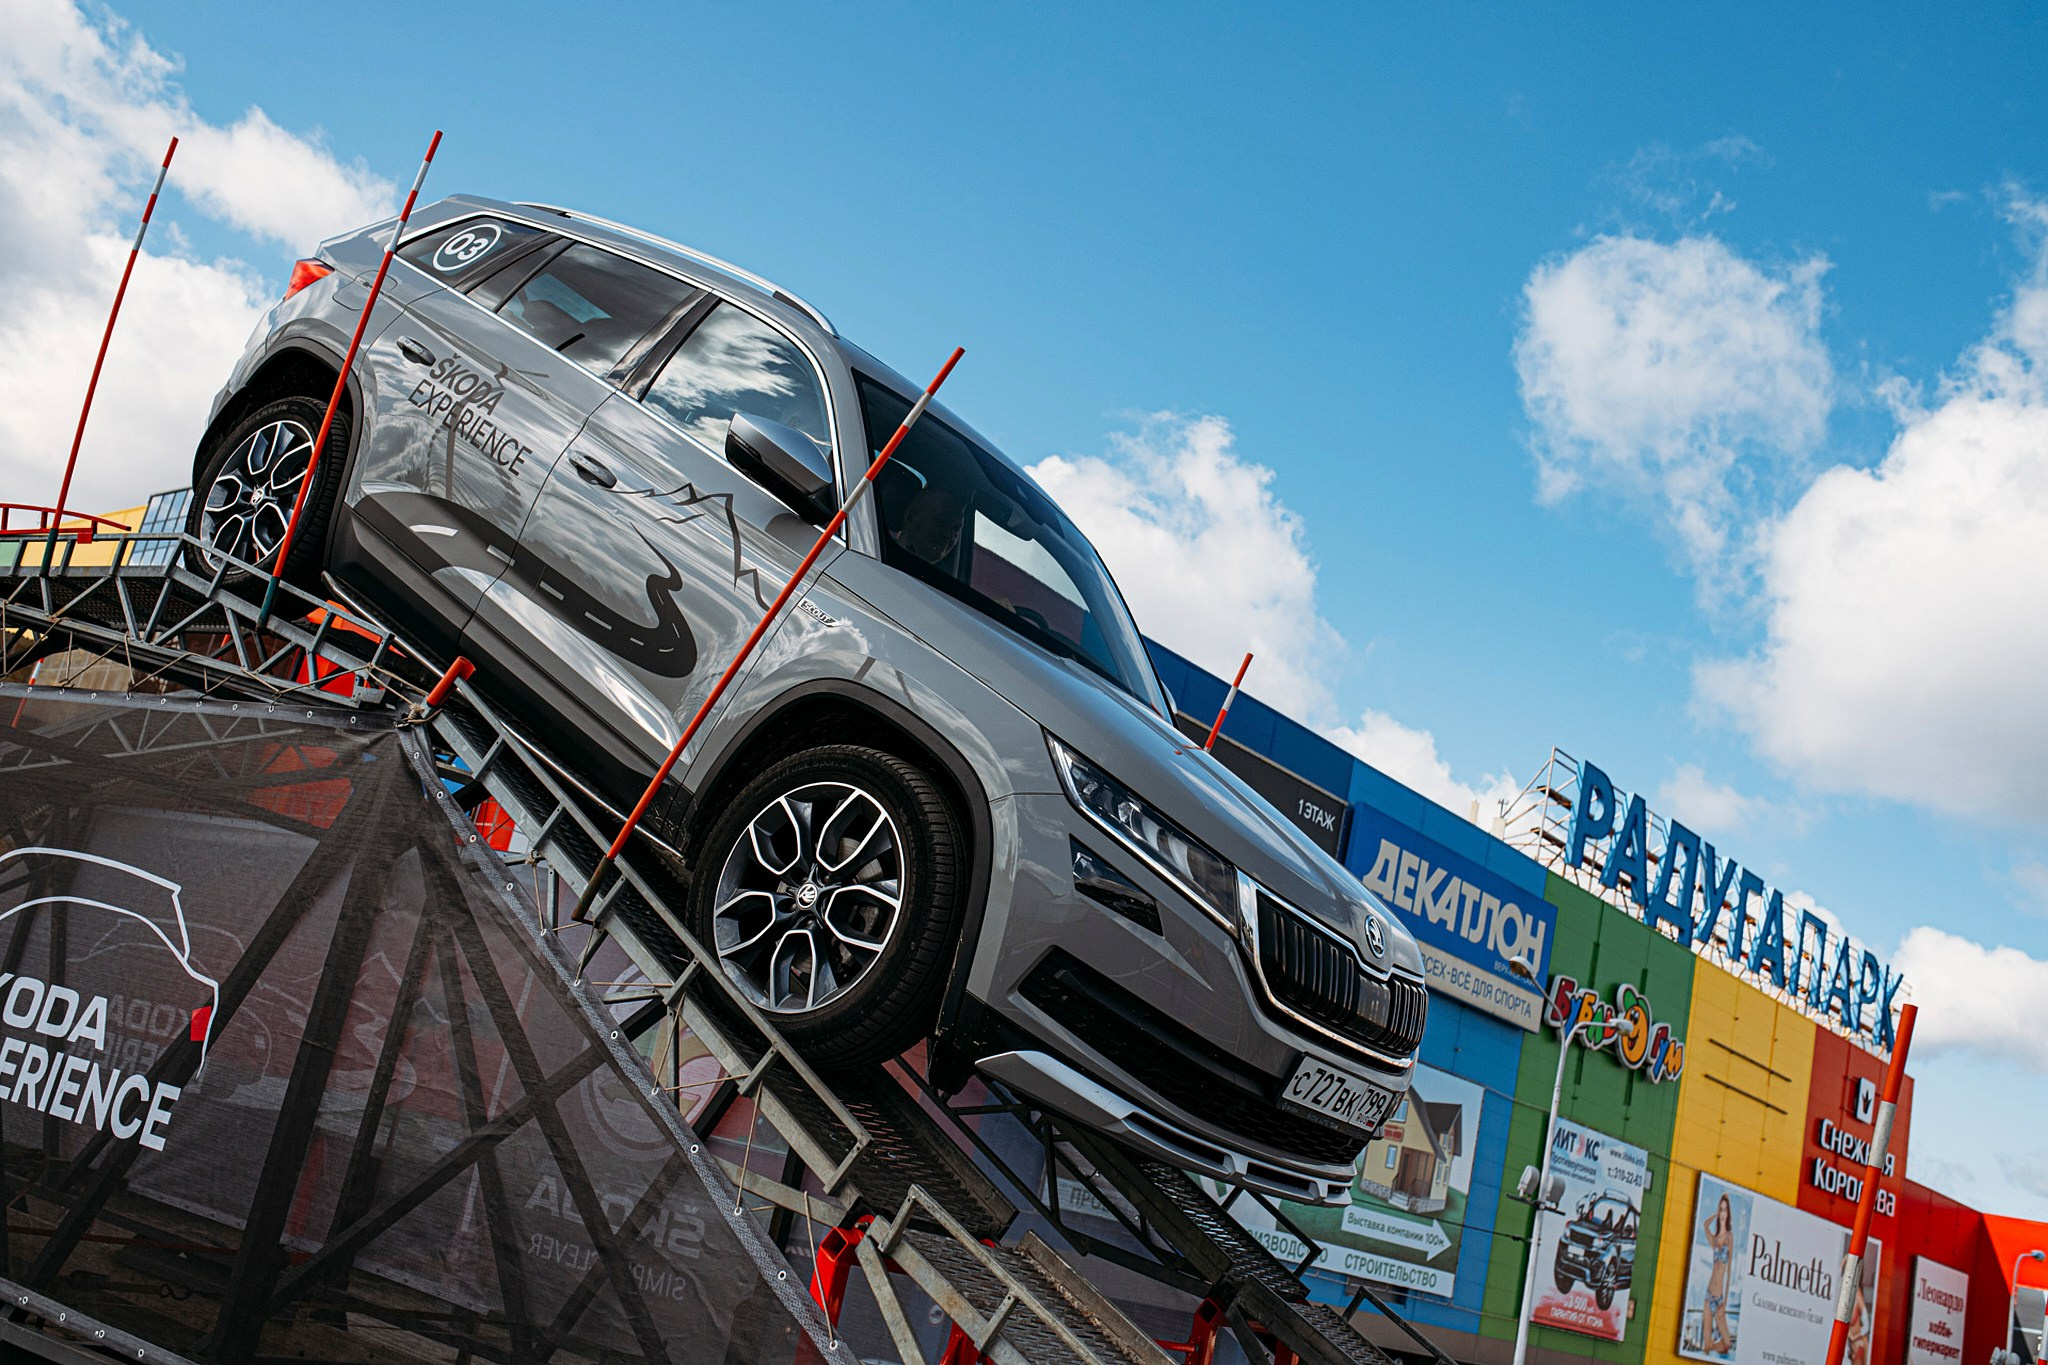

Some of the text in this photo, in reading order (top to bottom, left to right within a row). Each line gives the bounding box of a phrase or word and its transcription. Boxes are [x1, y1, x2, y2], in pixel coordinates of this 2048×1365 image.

[444, 232, 489, 261] 03
[429, 353, 505, 416] ŠKODA
[407, 378, 533, 477] EXPERIENCE
[803, 601, 832, 624] SCOUT
[1298, 799, 1336, 832] 1 ЭТАЖ
[1363, 838, 1546, 976] ДЕКАТЛОН
[1567, 760, 1904, 1054] РАДУГА ПАРК
[0, 972, 108, 1051] ODA
[1472, 978, 1494, 1000] ДЛЯ
[1494, 988, 1532, 1018] СПОРТА
[1820, 1118, 1896, 1178] Снежя
[1814, 1157, 1896, 1217] Корова
[1347, 1212, 1386, 1233] Выставка
[1344, 1253, 1437, 1288] СТРОИТЕЛЬСТВО
[1748, 1232, 1832, 1301] Palmetta
